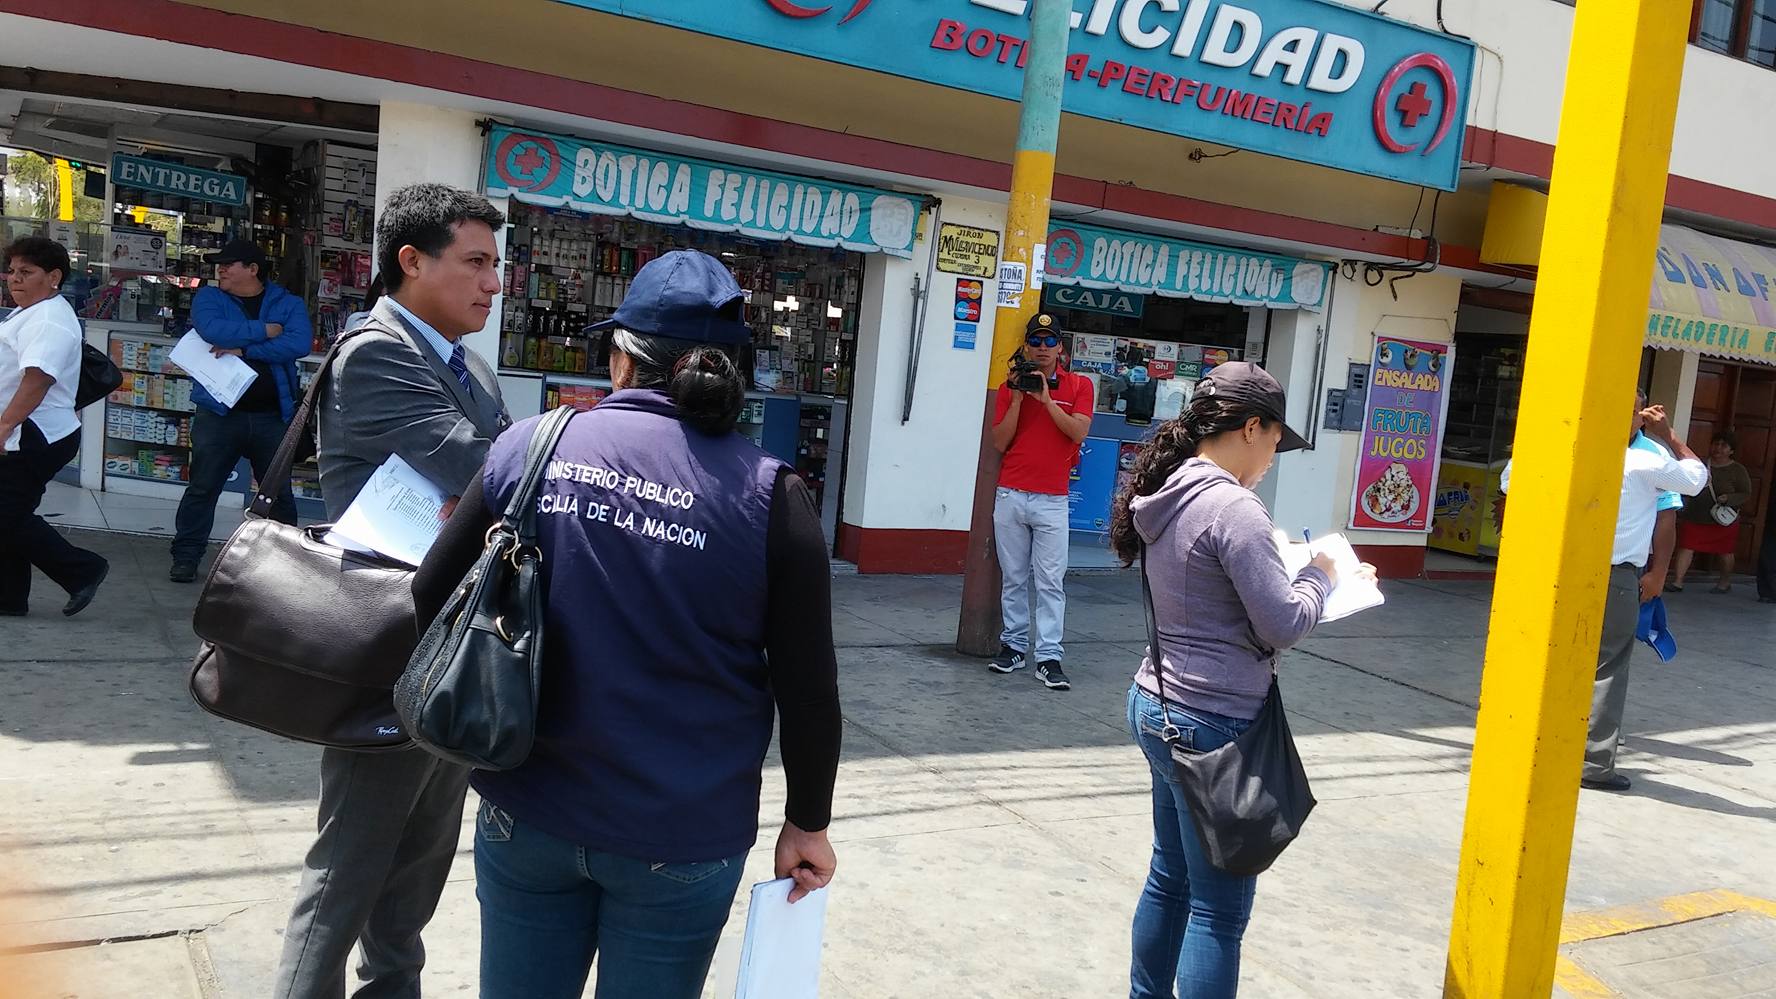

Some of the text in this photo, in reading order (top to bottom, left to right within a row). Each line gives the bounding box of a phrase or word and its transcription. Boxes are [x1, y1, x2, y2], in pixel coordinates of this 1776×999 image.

[970, 0, 1366, 94] ICIDAD
[930, 18, 1334, 138] BOTIA-PERFUMERÍA
[119, 160, 237, 200] ENTREGA
[572, 147, 692, 215] BOTICA
[704, 169, 861, 239] FELICIDAD
[957, 230, 984, 239] JIRON
[1090, 237, 1169, 285] BOTICA
[1175, 250, 1284, 299] FELICIDAD
[1055, 288, 1134, 313] CAJA
[1081, 361, 1103, 369] CAJA
[1179, 363, 1198, 372] CMR
[1374, 368, 1440, 392] ENSALADA
[1396, 391, 1416, 407] DE
[1371, 407, 1433, 436] FRUTA
[1369, 435, 1427, 461] JUGOS
[543, 459, 694, 510] INISTERIO PUBLICO
[586, 502, 610, 523] DE
[613, 508, 634, 531] LA
[641, 517, 707, 551] NACION
